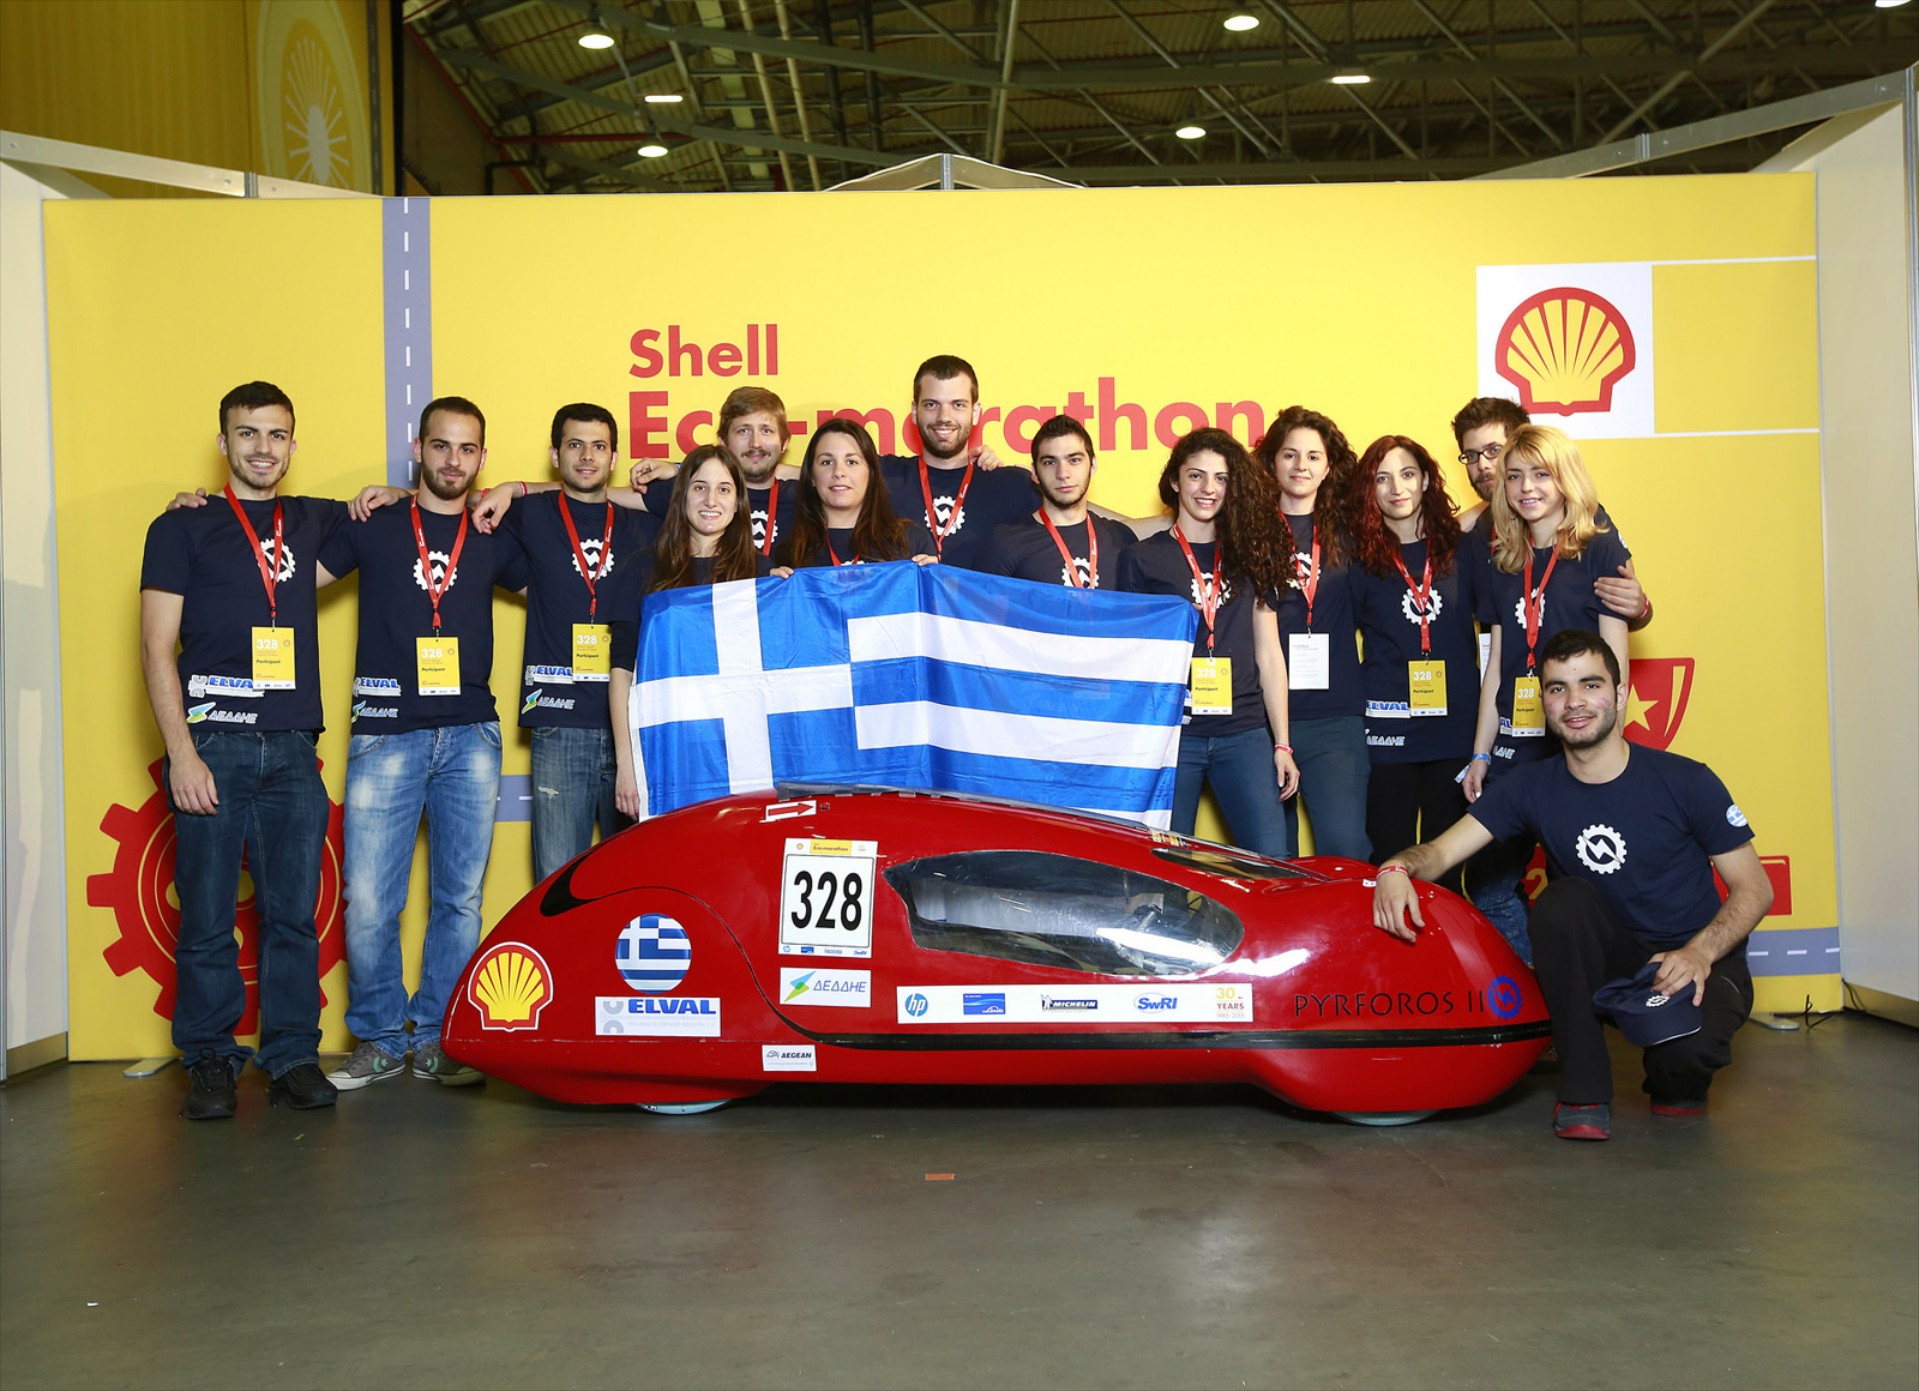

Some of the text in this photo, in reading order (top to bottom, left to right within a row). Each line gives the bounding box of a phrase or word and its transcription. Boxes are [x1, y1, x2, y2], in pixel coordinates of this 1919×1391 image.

[629, 323, 778, 378] Shell
[256, 639, 279, 650] 328
[576, 635, 598, 645] 328
[421, 648, 443, 658] 328
[1195, 667, 1217, 678] 328
[1412, 671, 1432, 681] 328
[209, 677, 253, 689] ELVA
[361, 678, 399, 688] ELVAL
[1517, 688, 1535, 698] 328
[791, 870, 863, 931] 328
[1216, 987, 1236, 999] 30
[628, 999, 717, 1014] ELVAL
[907, 993, 926, 1017] hp
[1137, 997, 1178, 1010] SwRI
[1295, 991, 1454, 1017] PYRFOROS
